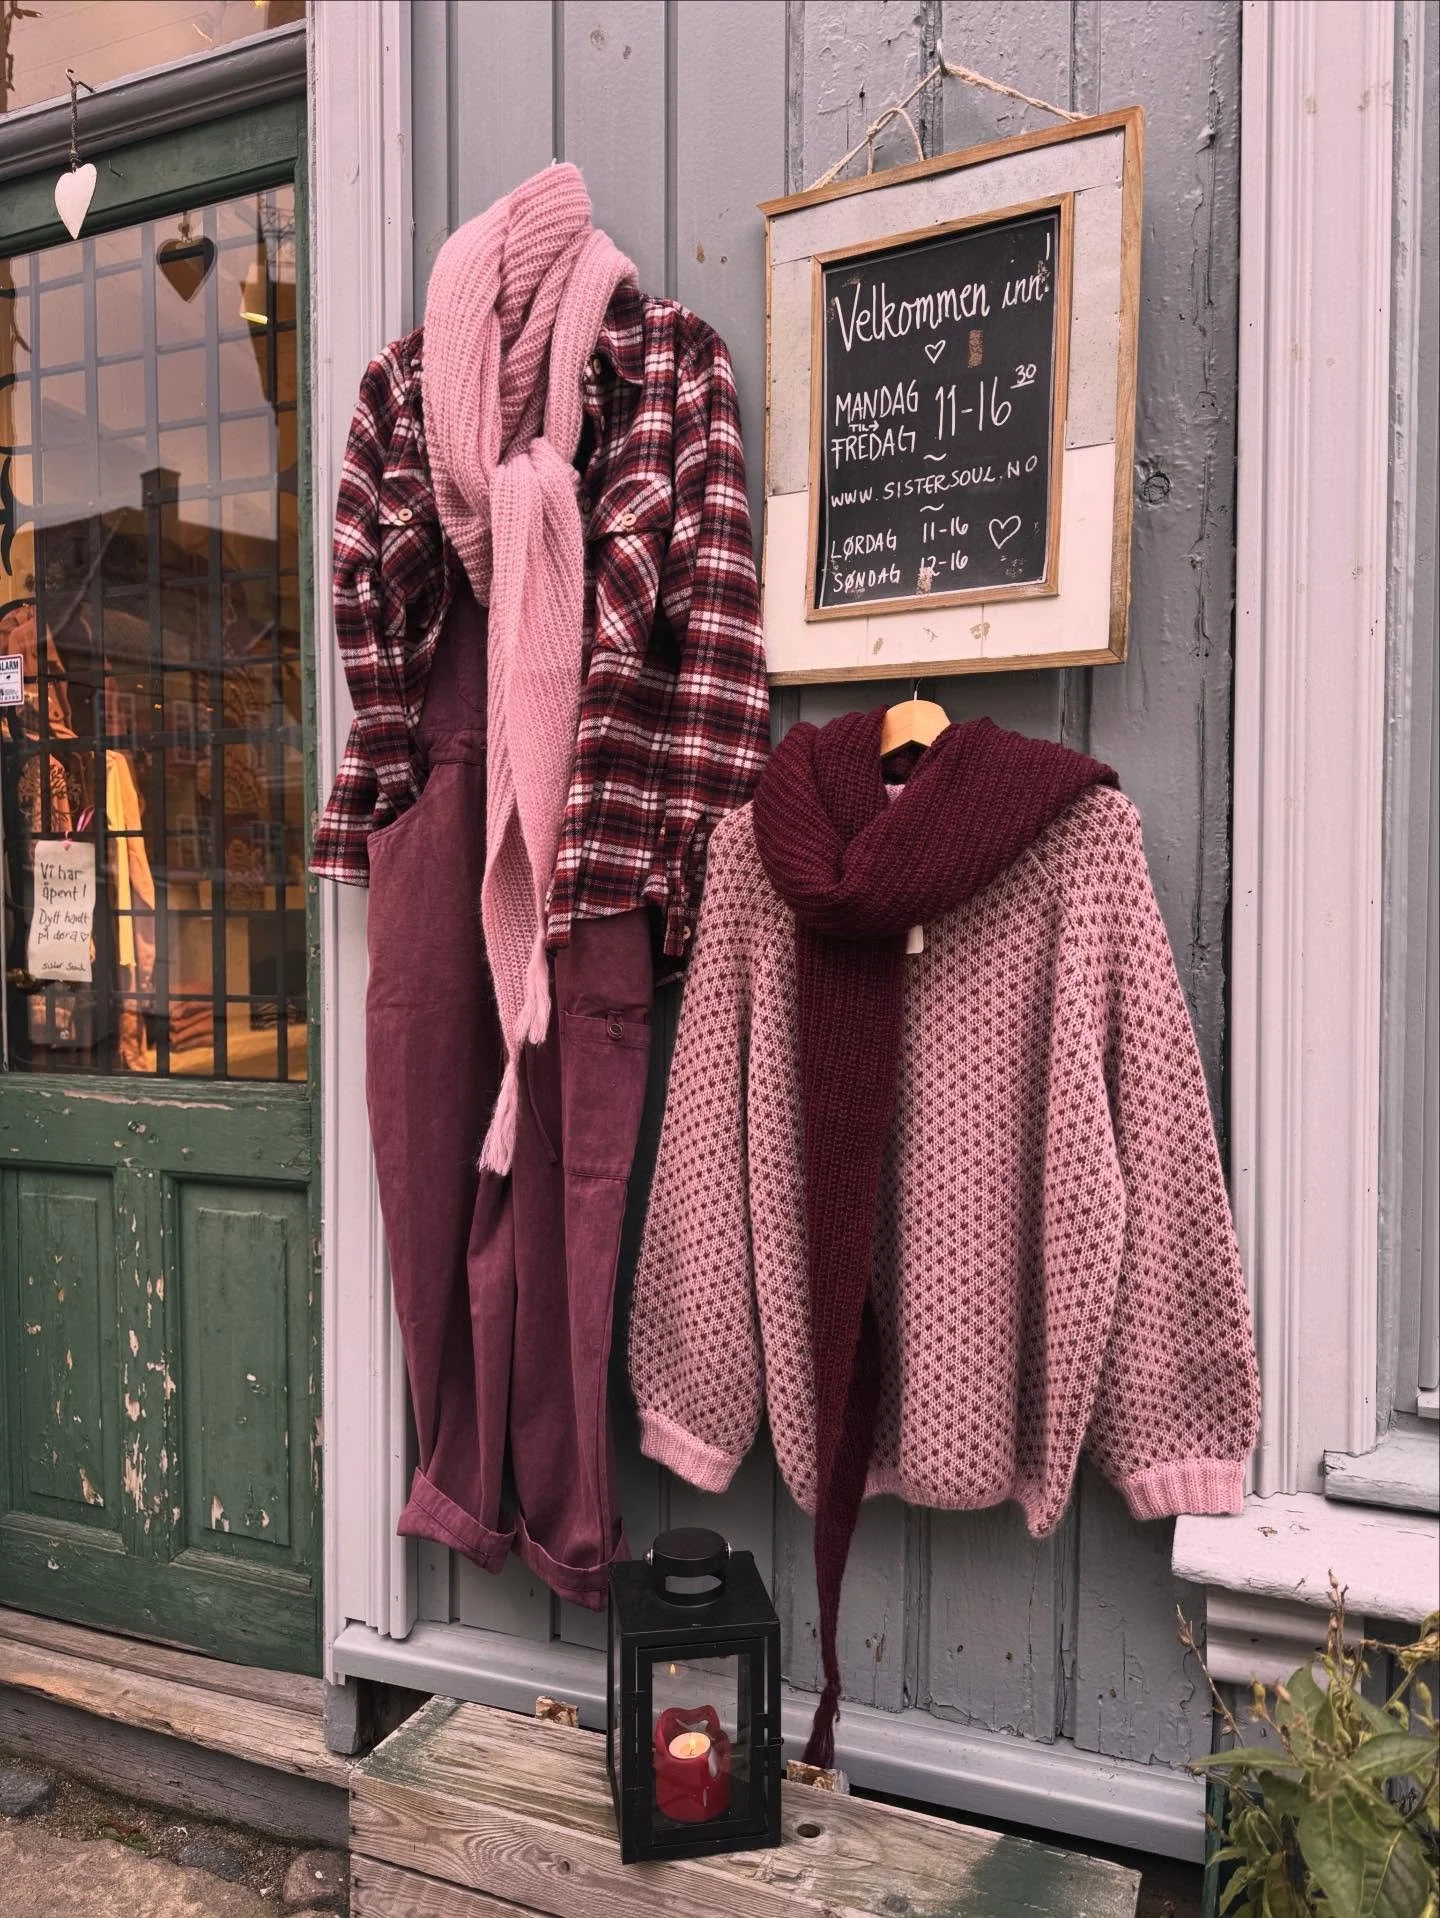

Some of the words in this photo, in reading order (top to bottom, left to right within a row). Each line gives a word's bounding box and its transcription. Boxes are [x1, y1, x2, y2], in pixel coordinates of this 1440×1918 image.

[834, 282, 991, 352] Velkommen
[835, 379, 919, 427] MANDAG
[934, 376, 1012, 440] 11-16
[1012, 363, 1037, 387] 30
[831, 425, 916, 469] FREDAG
[830, 529, 897, 561] LØRDAG
[922, 516, 969, 543] 11-16
[833, 564, 901, 593] SØNDAG
[920, 550, 969, 577] 12-16
[41, 862, 54, 879] Vi
[58, 864, 84, 880] har
